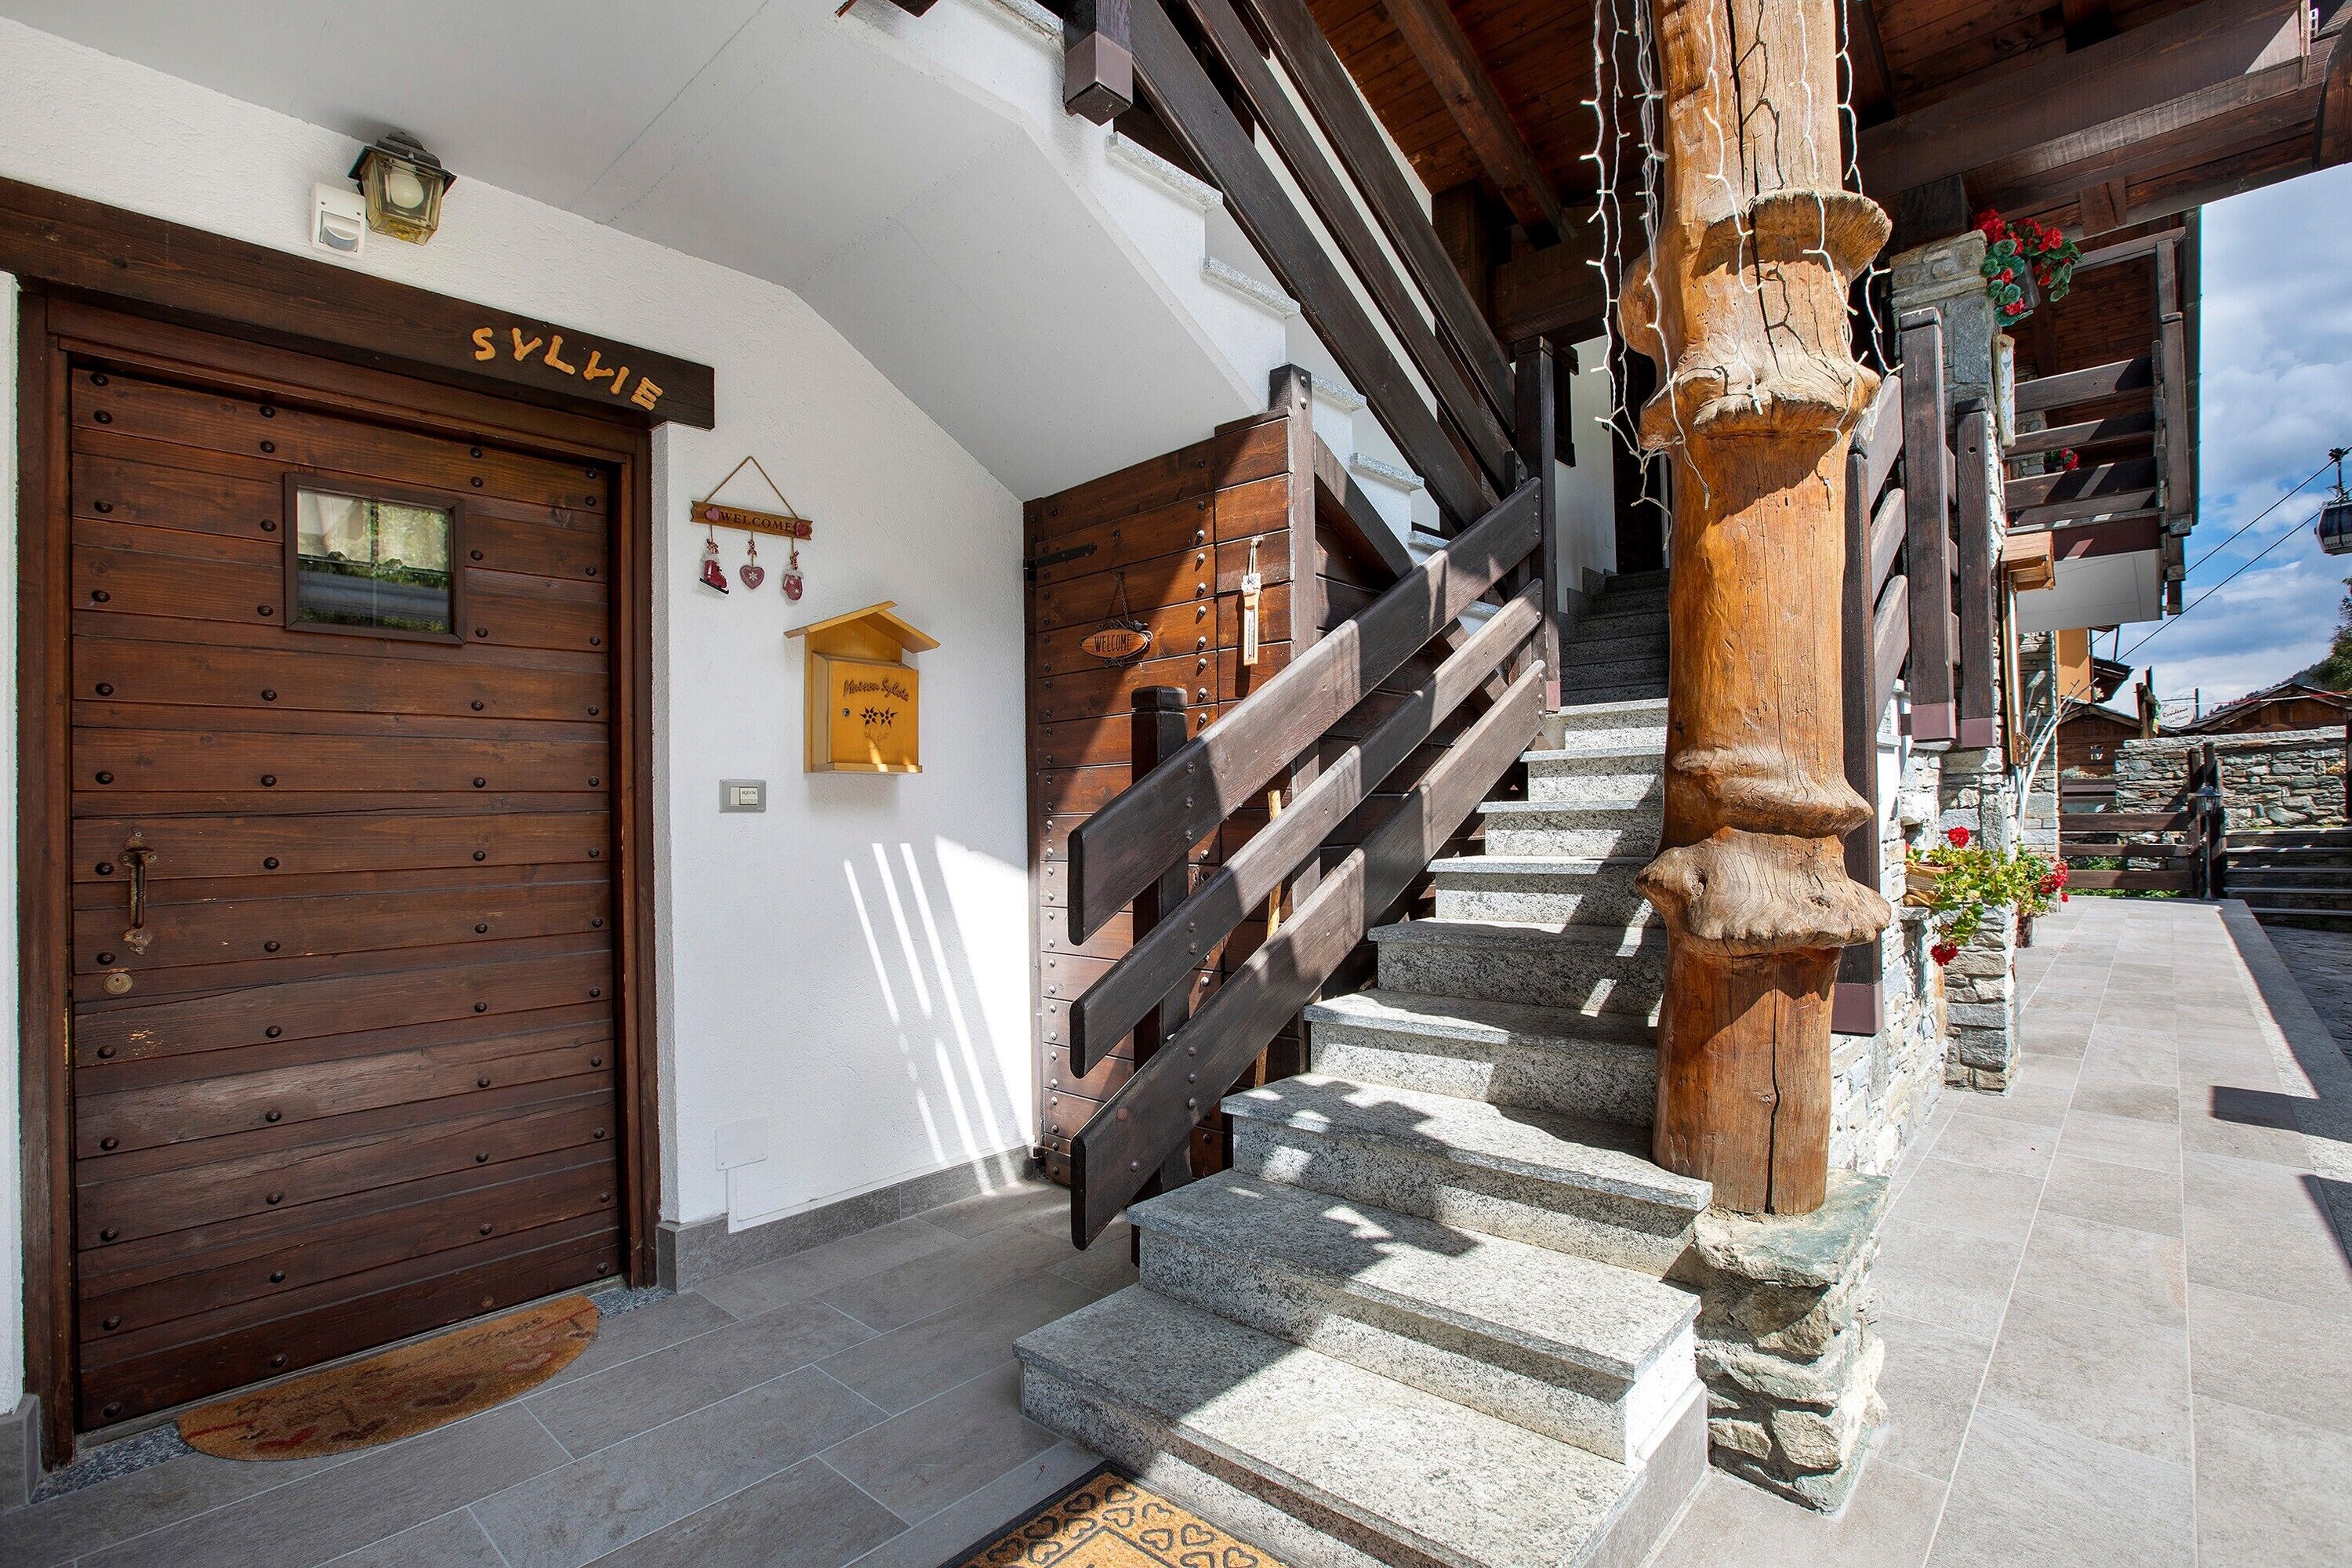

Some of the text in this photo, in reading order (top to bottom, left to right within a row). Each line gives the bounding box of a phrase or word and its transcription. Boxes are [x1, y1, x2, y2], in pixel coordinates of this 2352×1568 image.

[472, 327, 663, 411] SYLVIE
[718, 511, 793, 532] WELCOME
[1094, 633, 1131, 652] WELCOME
